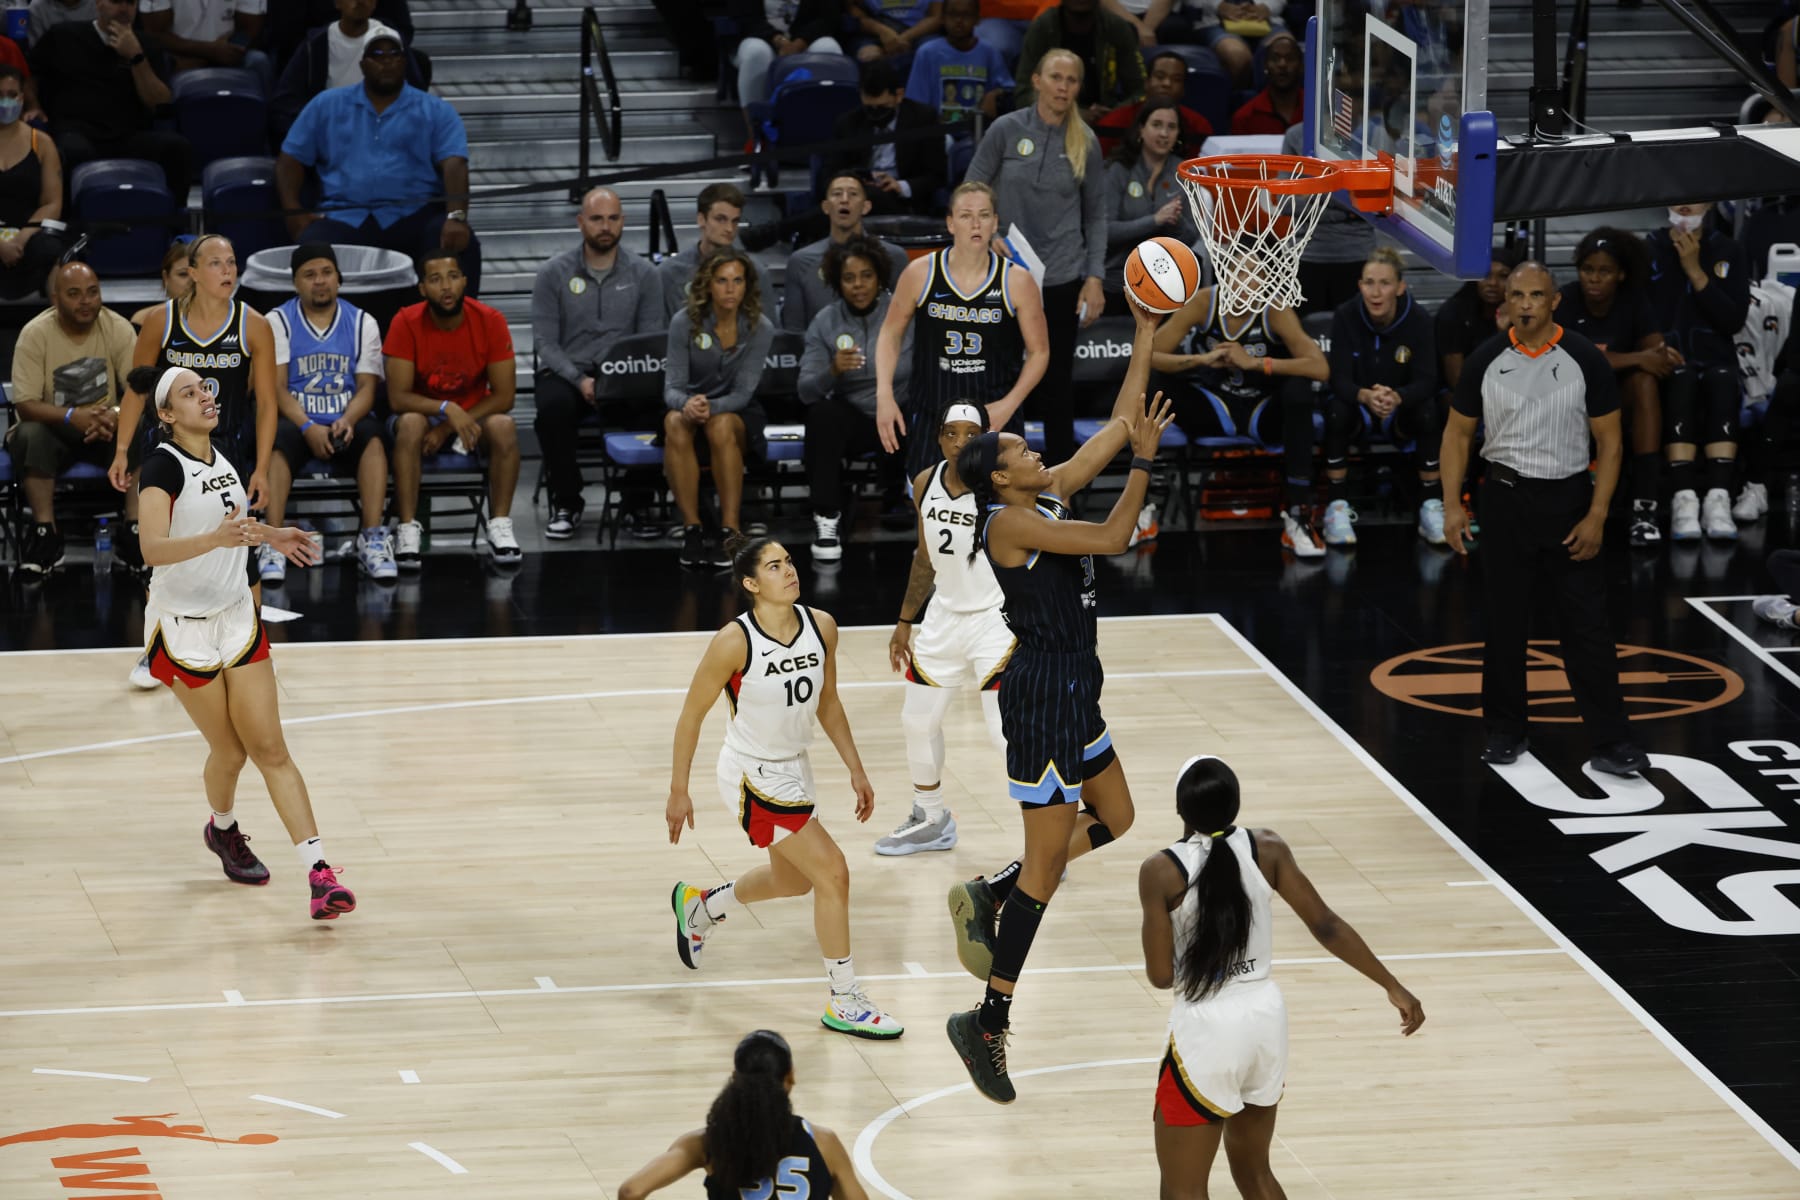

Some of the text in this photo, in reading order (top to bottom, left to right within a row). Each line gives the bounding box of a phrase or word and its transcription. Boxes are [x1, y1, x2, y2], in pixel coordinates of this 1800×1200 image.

[928, 302, 1003, 323] CHICAGO
[944, 330, 983, 355] 33
[1073, 339, 1133, 358] oinba
[166, 348, 241, 368] CHICAGO
[297, 352, 350, 376] NORTH
[763, 354, 800, 369] NB
[303, 371, 345, 394] 23
[202, 473, 237, 494] ACES
[220, 491, 236, 516] 5
[926, 506, 976, 527] ACES
[938, 528, 954, 555] 2
[1080, 556, 1095, 587] 3
[764, 652, 819, 677] ACES
[783, 676, 813, 707] 10
